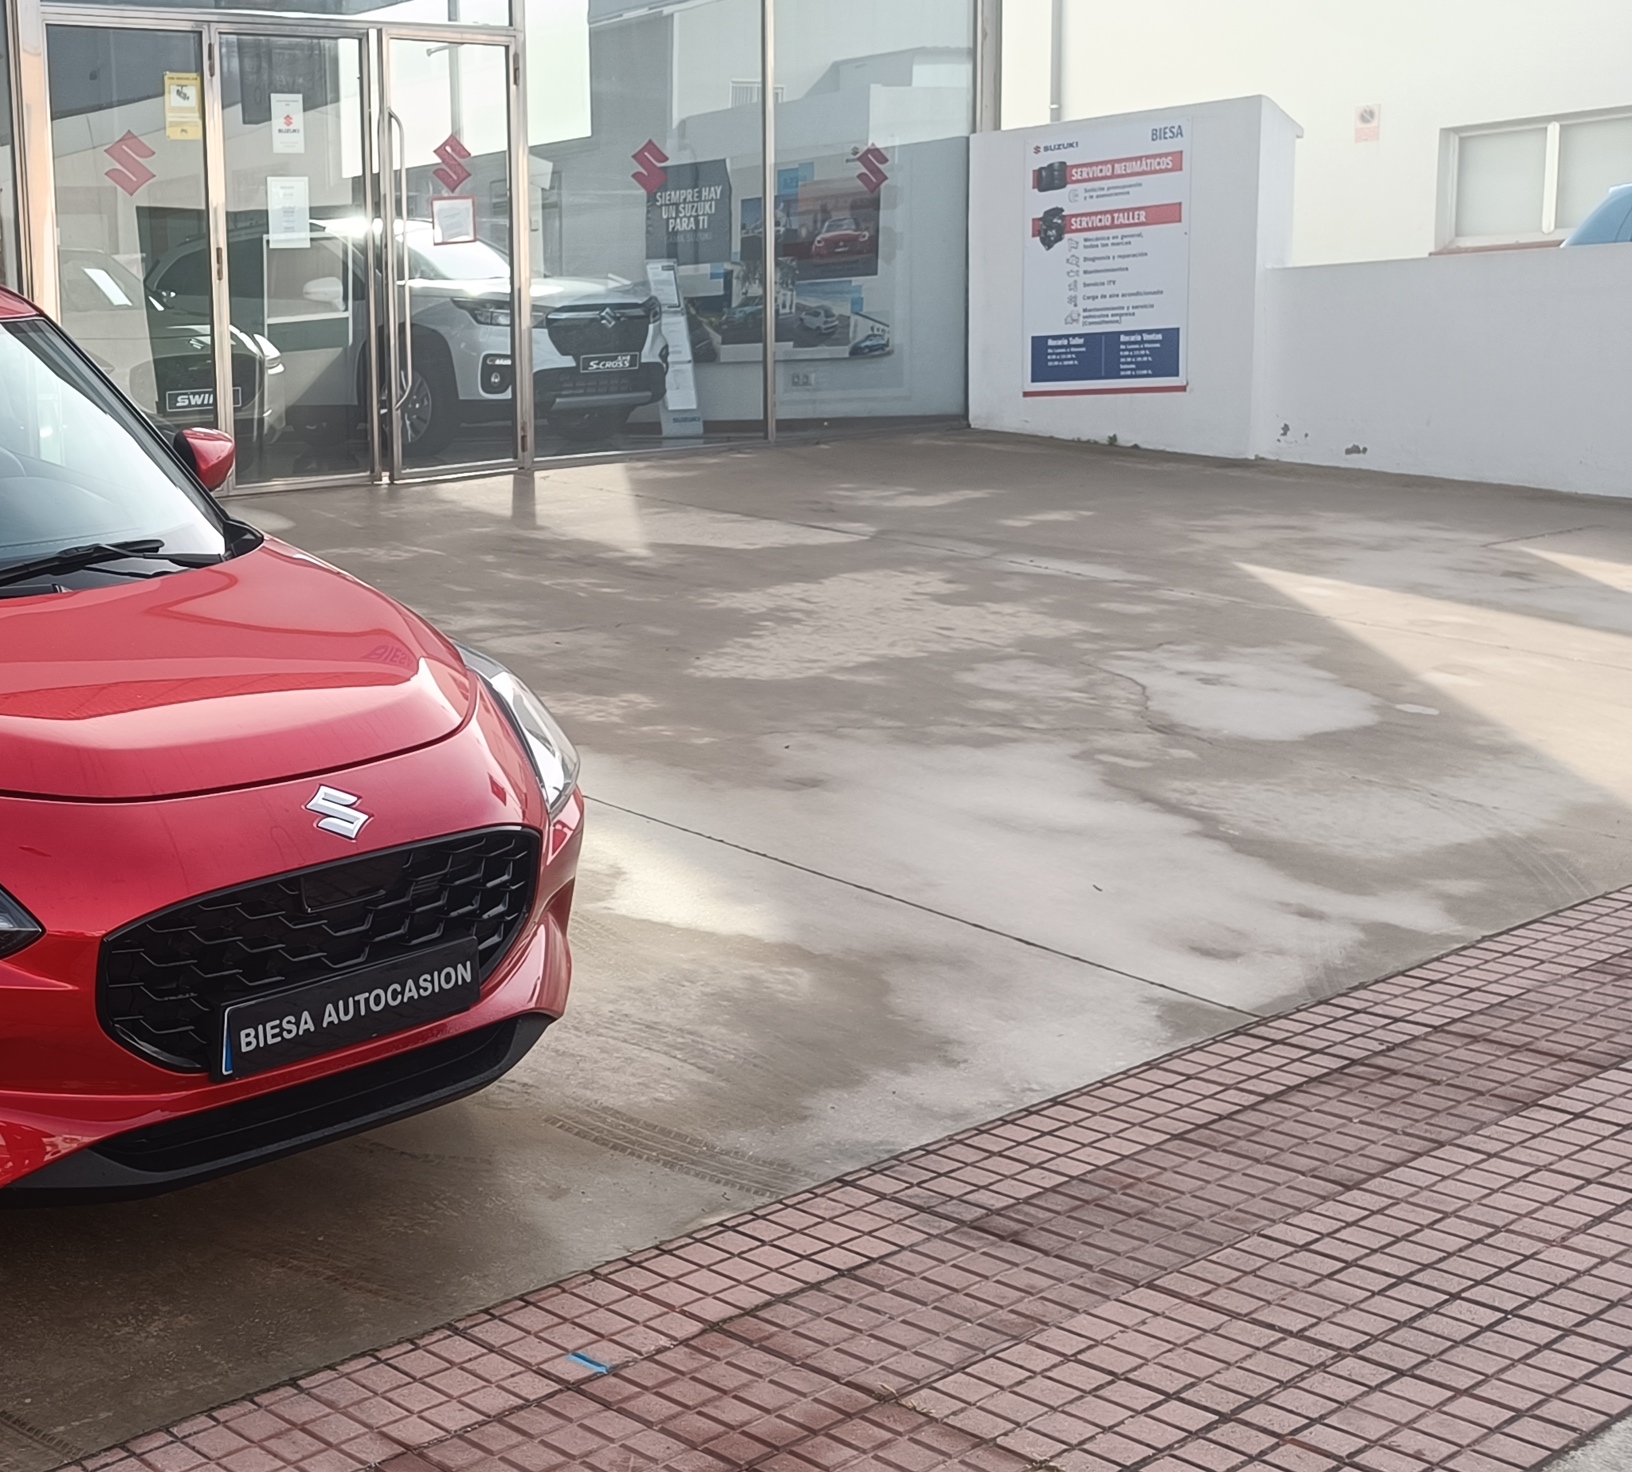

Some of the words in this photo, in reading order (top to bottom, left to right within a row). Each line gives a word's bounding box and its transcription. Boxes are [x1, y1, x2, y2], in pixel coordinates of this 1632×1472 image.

[1151, 125, 1184, 141] BIESA
[1043, 141, 1079, 152] SUZUKI
[1071, 164, 1112, 180] SERVICIO
[1114, 156, 1173, 175] NEUMÁTICOS
[656, 188, 699, 206] SIEMPRE
[702, 185, 722, 200] HAY
[662, 205, 676, 219] UN
[678, 201, 715, 217] SUZUKI
[668, 217, 696, 232] PARA
[697, 216, 708, 229] TI
[1071, 214, 1112, 229] SERVICIO
[1113, 210, 1146, 225] TALLER
[176, 393, 213, 406] SWI
[239, 1010, 315, 1053] BIESA
[322, 961, 472, 1028] AUTOCASION
